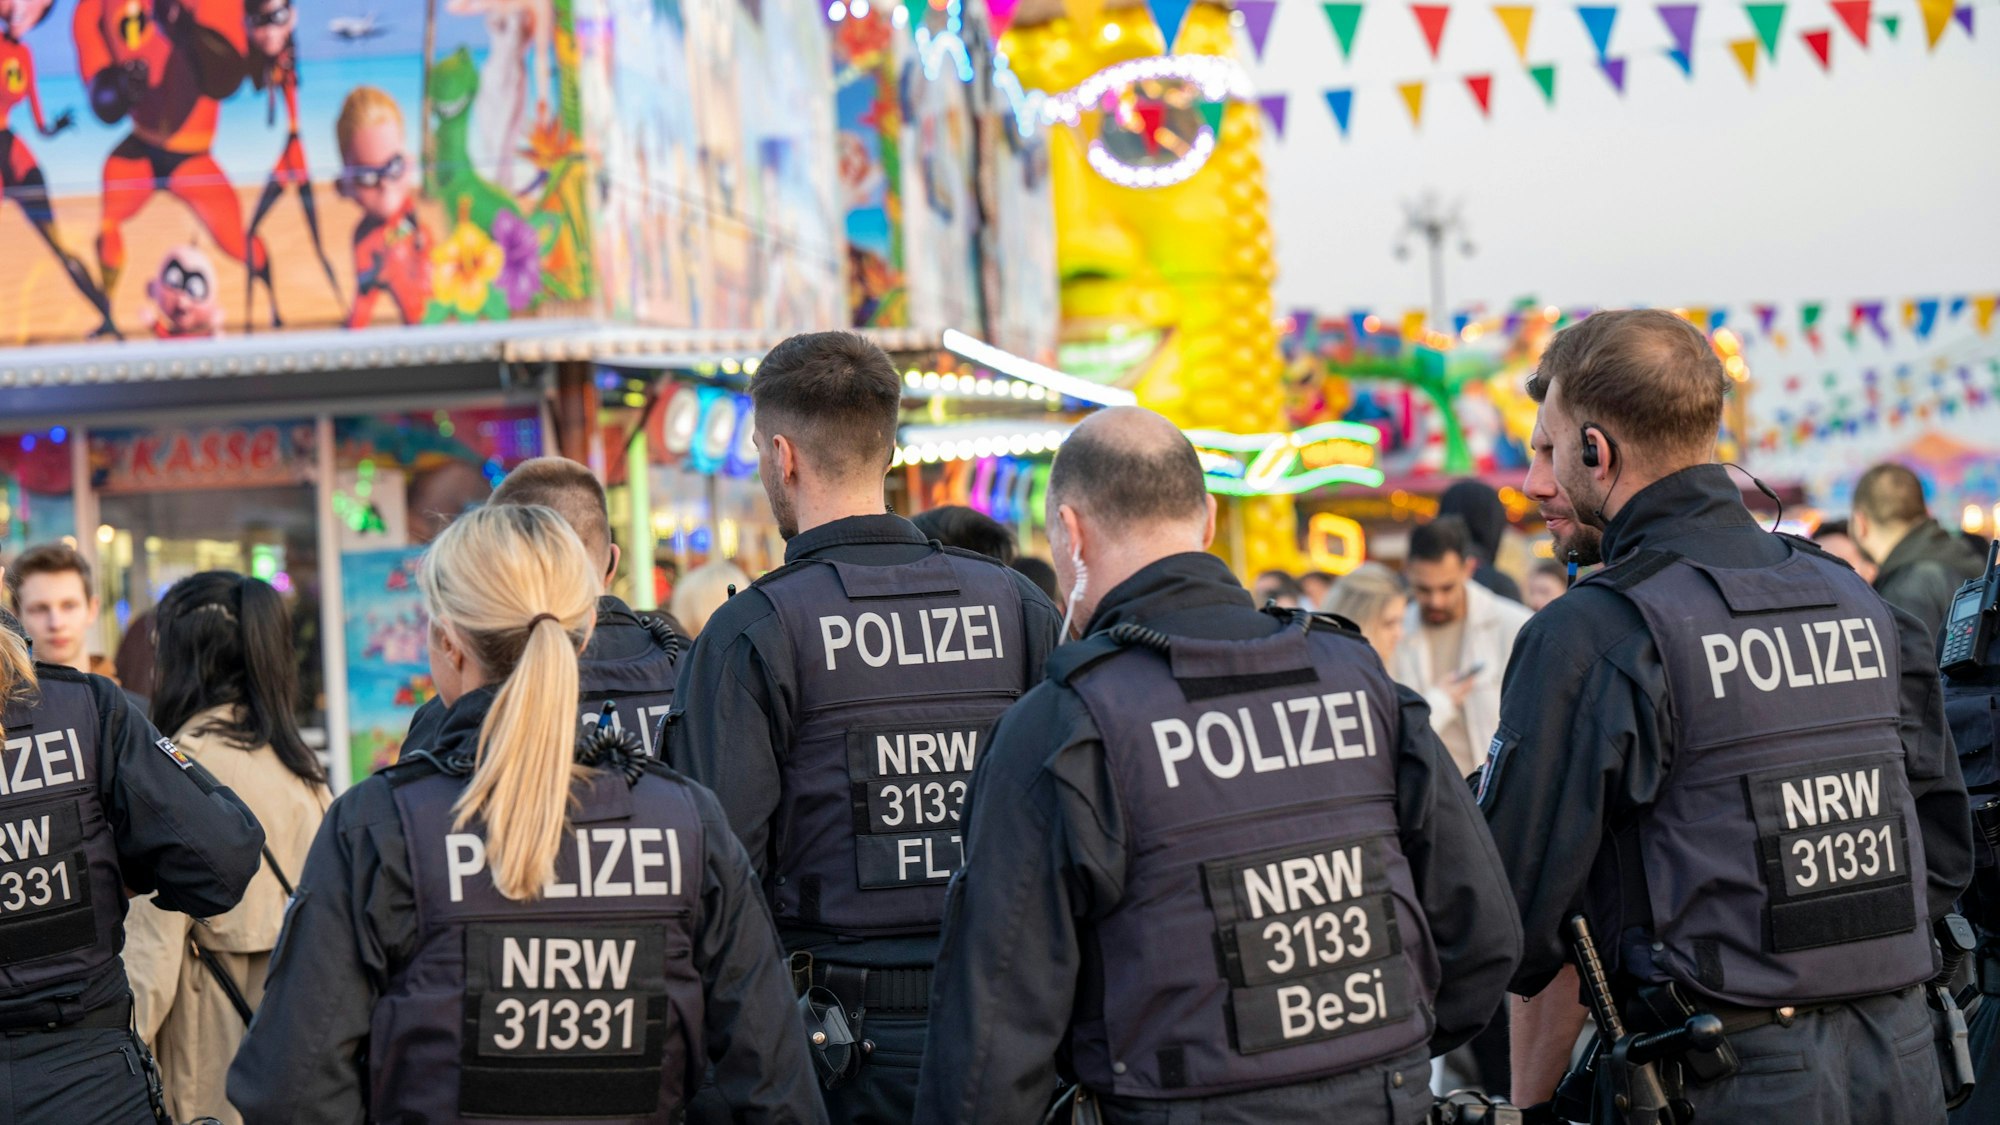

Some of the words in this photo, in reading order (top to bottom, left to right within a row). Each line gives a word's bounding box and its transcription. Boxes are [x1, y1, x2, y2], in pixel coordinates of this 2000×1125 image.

[819, 605, 1004, 671] POLIZEI
[1701, 617, 1887, 699] POLIZEI
[876, 731, 977, 776] NRW
[1151, 690, 1376, 788] POLIZEI
[880, 780, 967, 826] 3133
[1781, 768, 1880, 830] NRW
[0, 861, 71, 912] 331
[445, 828, 682, 902] PIZEI
[1243, 846, 1363, 920] NRW
[1791, 825, 1896, 887] 31331
[502, 937, 636, 990] NRW
[1262, 905, 1372, 975] 3133
[493, 998, 635, 1050] 31331
[1276, 968, 1387, 1040] BeSi
